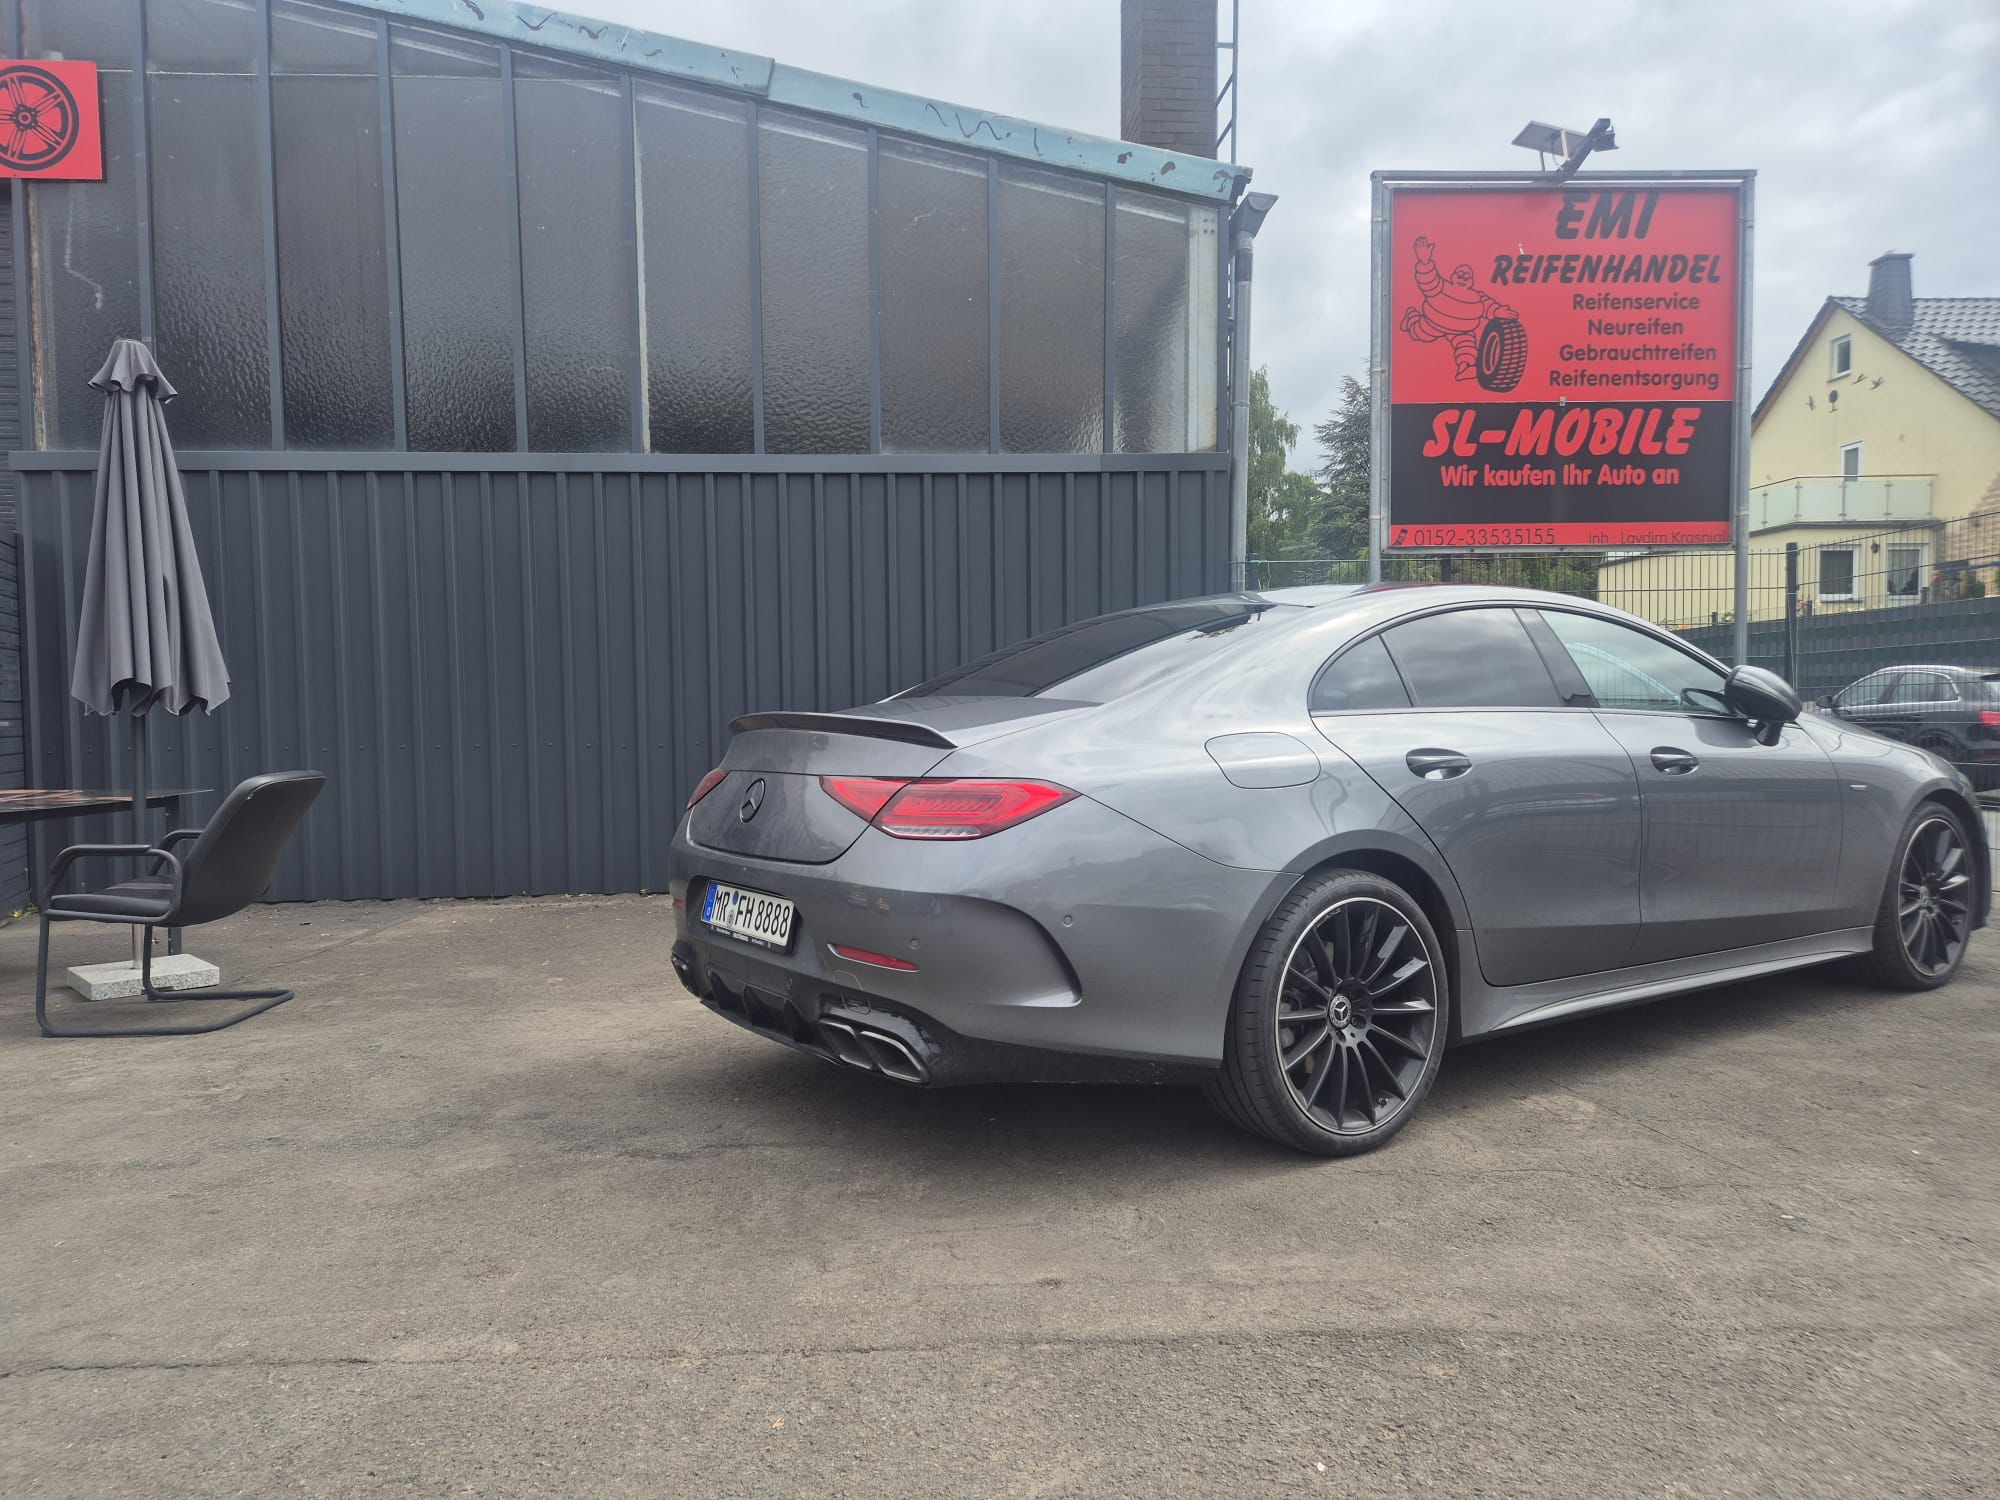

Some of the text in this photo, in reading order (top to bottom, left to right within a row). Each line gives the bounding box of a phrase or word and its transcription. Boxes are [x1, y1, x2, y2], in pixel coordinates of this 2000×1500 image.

[1555, 190, 1661, 240] EMI
[1490, 254, 1722, 286] REIFENHANDEL
[1572, 292, 1701, 311] Reifenservice
[1588, 318, 1684, 336] Neureifen
[1559, 343, 1717, 361] Gebrauchtreifen
[1549, 369, 1720, 390] Reifenentsorgung
[1423, 407, 1702, 457] SL-MOBILE
[1440, 463, 1680, 487] Wir kaufen Ihr Auto an
[1414, 528, 1556, 545] 0152-33535155
[712, 890, 730, 922] MR
[735, 896, 756, 929] FH
[754, 900, 790, 938] 8888
